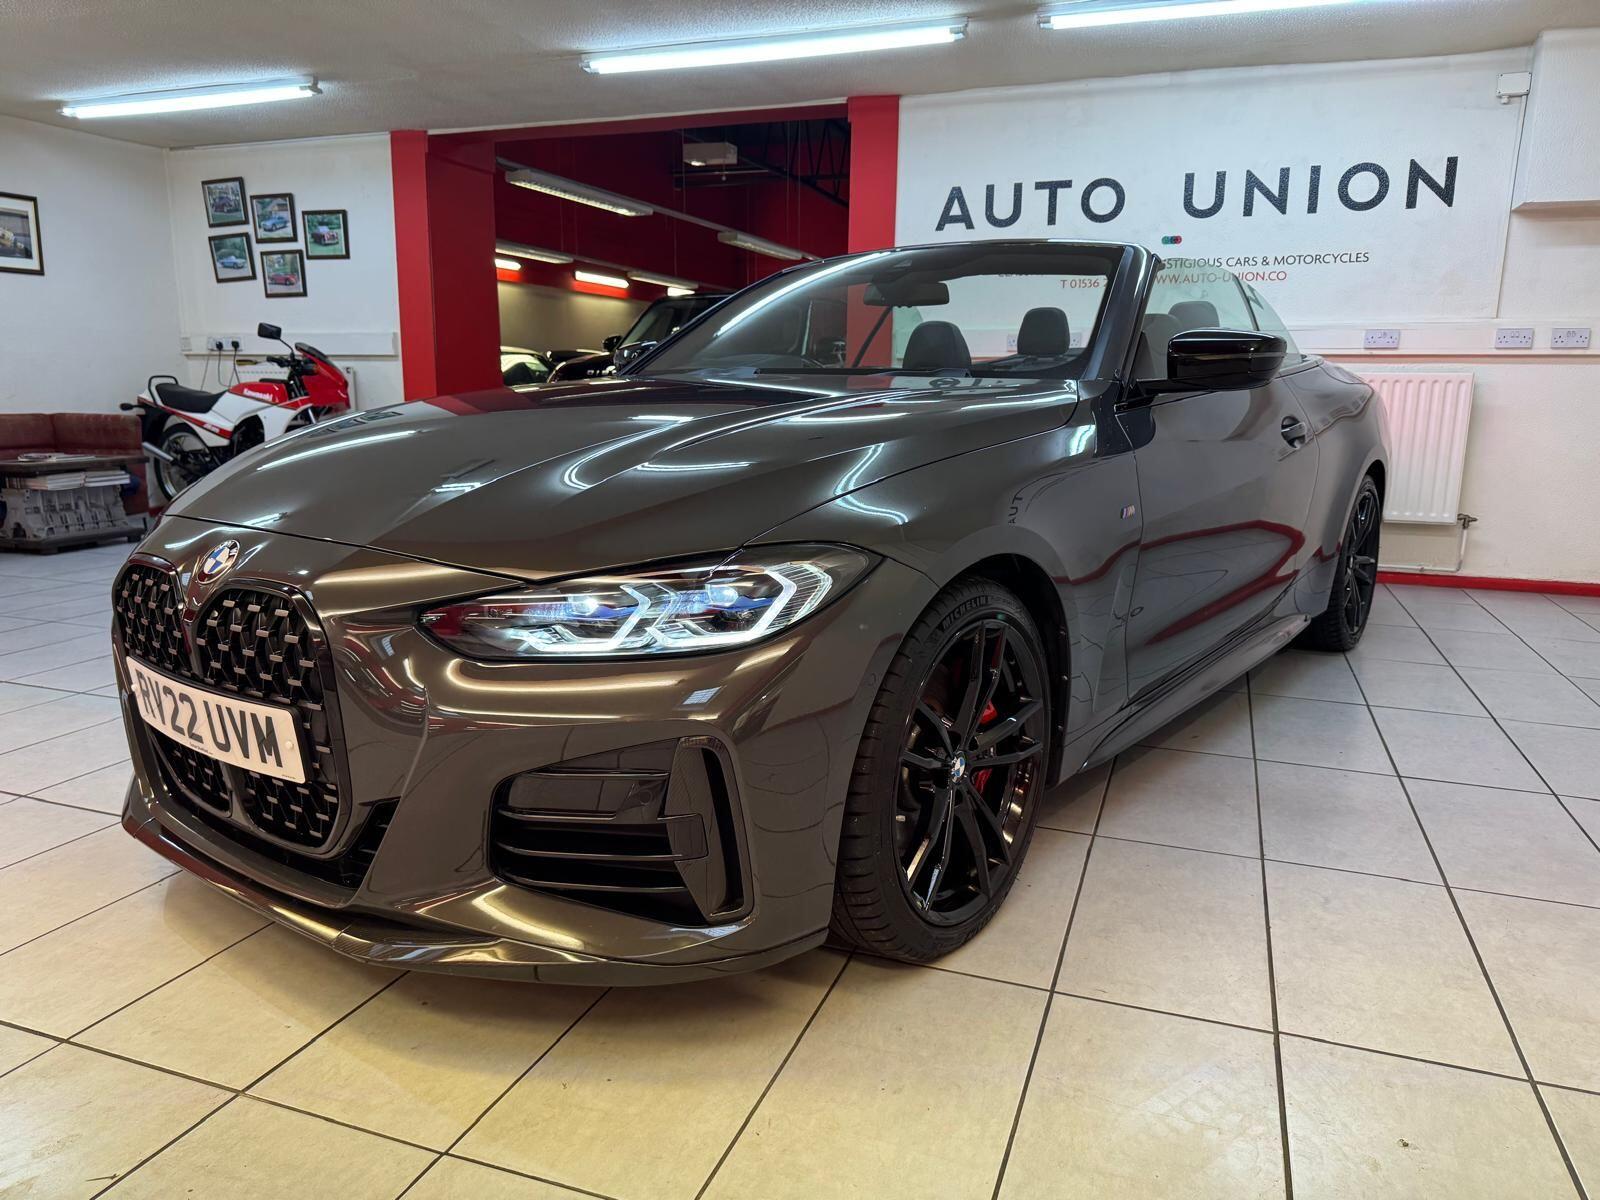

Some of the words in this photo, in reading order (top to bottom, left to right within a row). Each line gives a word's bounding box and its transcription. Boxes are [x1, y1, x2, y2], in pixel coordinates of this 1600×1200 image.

[934, 177, 1126, 232] AUTO
[1183, 156, 1459, 219] UNION
[1225, 255, 1258, 268] CARS
[1262, 255, 1271, 267] &
[1273, 252, 1370, 266] MOTORCYCLES
[1070, 279, 1100, 289] 01536
[135, 669, 204, 745] RV22
[202, 700, 283, 769] UVM
